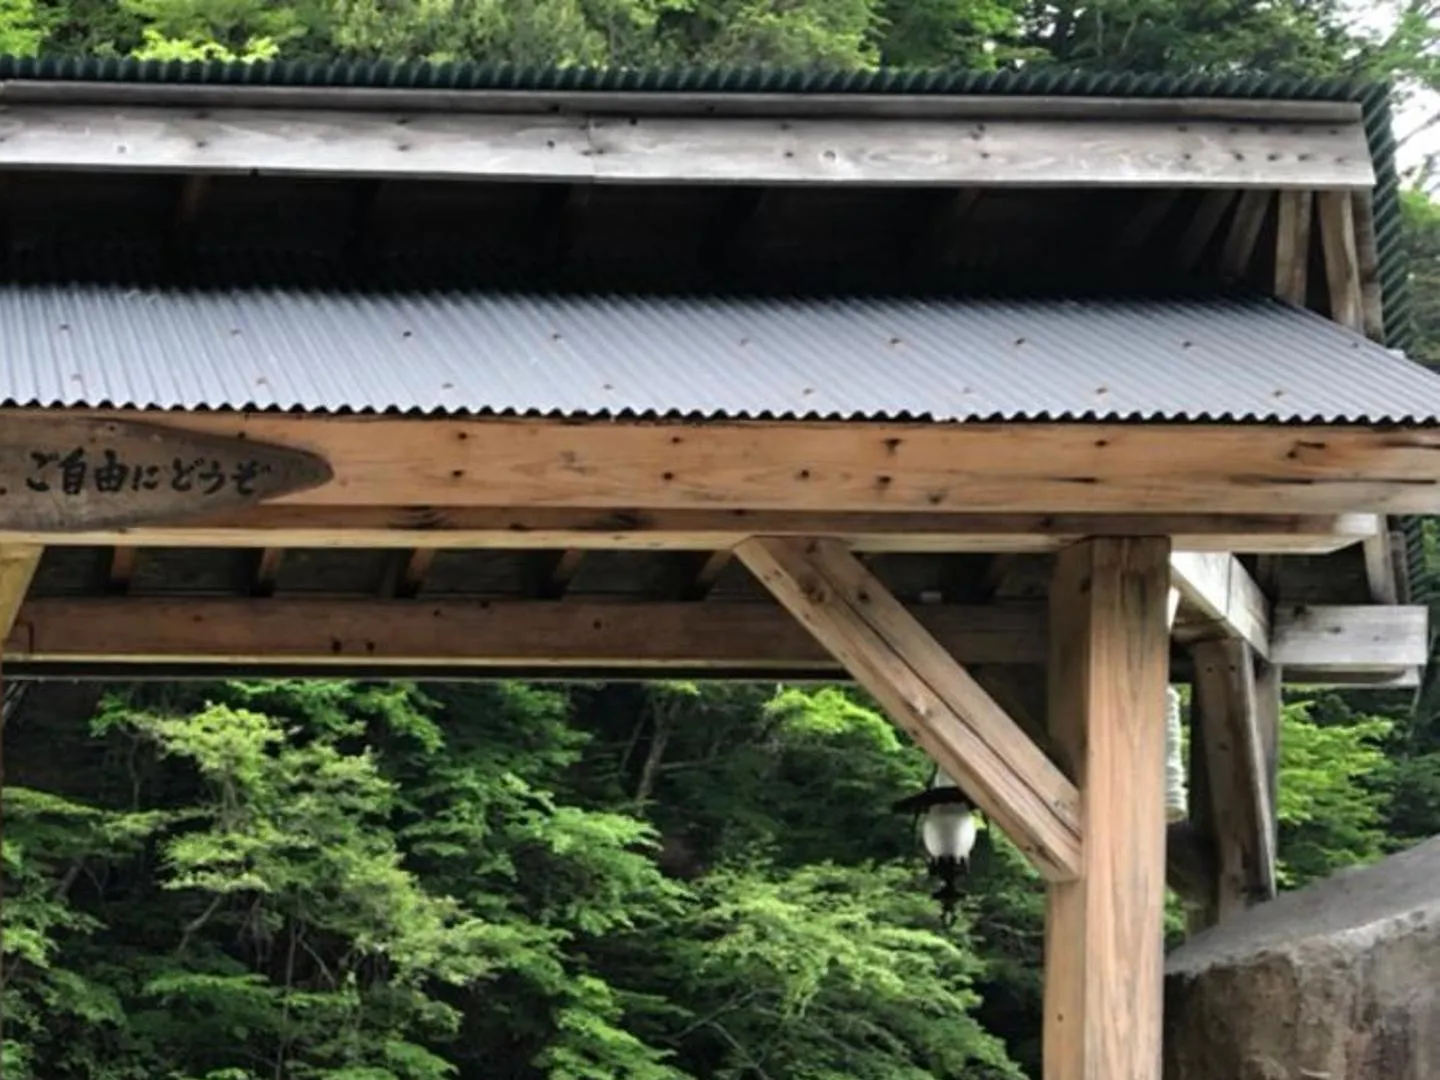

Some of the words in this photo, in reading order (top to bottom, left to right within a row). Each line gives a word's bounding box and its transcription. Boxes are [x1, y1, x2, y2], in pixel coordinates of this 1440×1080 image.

[26, 447, 271, 495] ご自由にどうぞ
